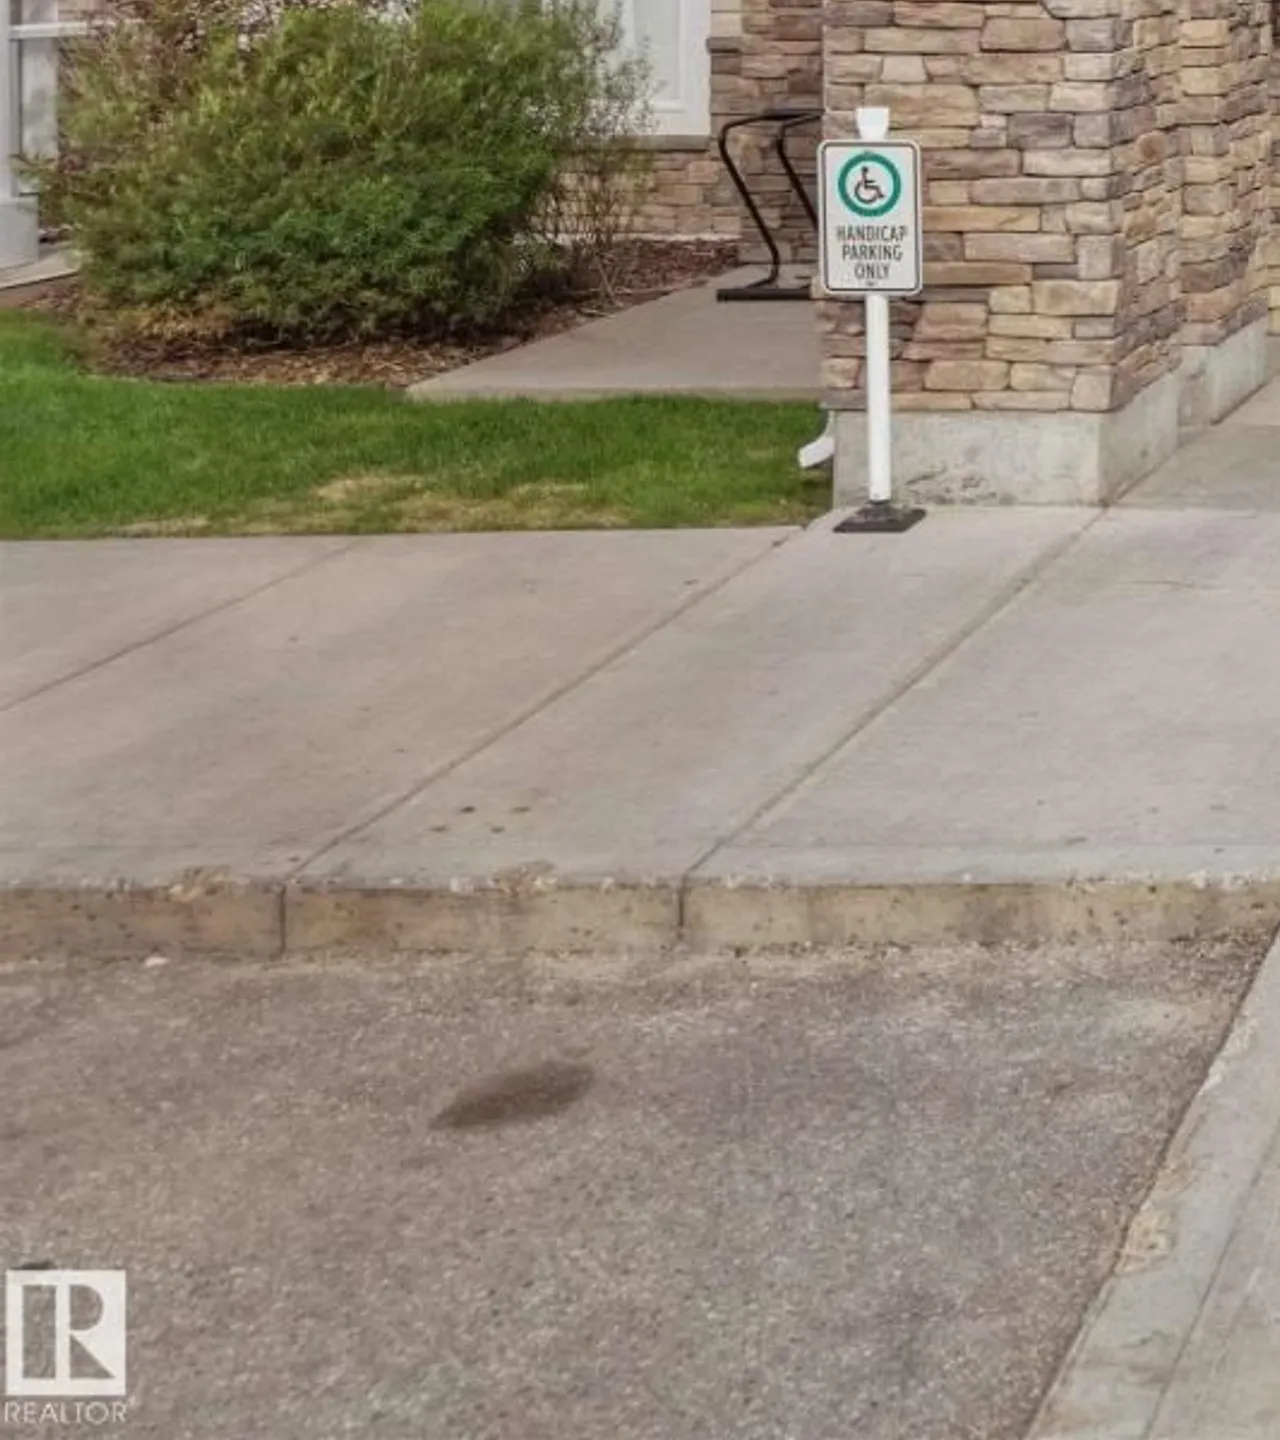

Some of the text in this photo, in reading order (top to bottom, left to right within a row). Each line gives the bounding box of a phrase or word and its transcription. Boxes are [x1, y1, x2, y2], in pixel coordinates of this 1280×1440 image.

[836, 225, 907, 242] HANDICAP
[842, 244, 904, 261] PARKING
[854, 262, 890, 279] ONLY
